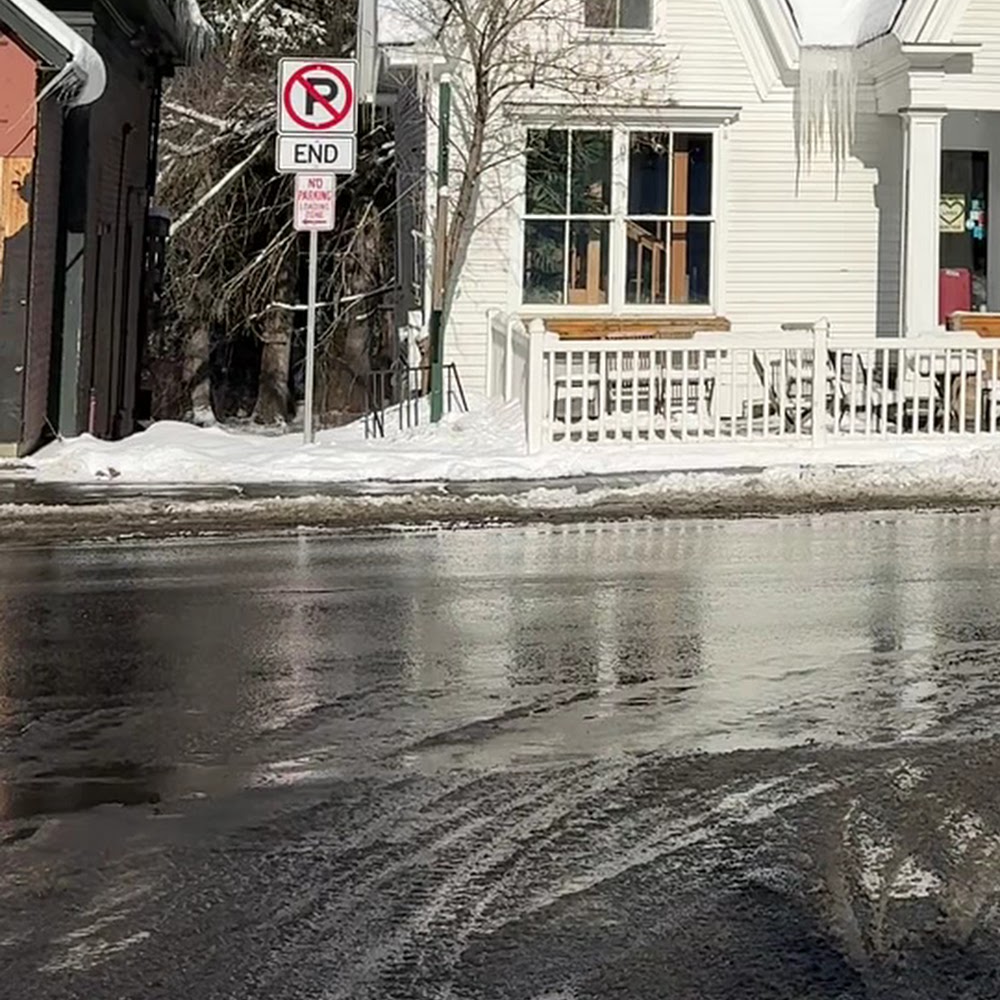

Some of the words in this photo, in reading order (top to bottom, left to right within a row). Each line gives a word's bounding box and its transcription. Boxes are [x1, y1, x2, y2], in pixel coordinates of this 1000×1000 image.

[294, 144, 338, 164] END
[308, 178, 323, 189] NO
[297, 190, 331, 200] PARKING
